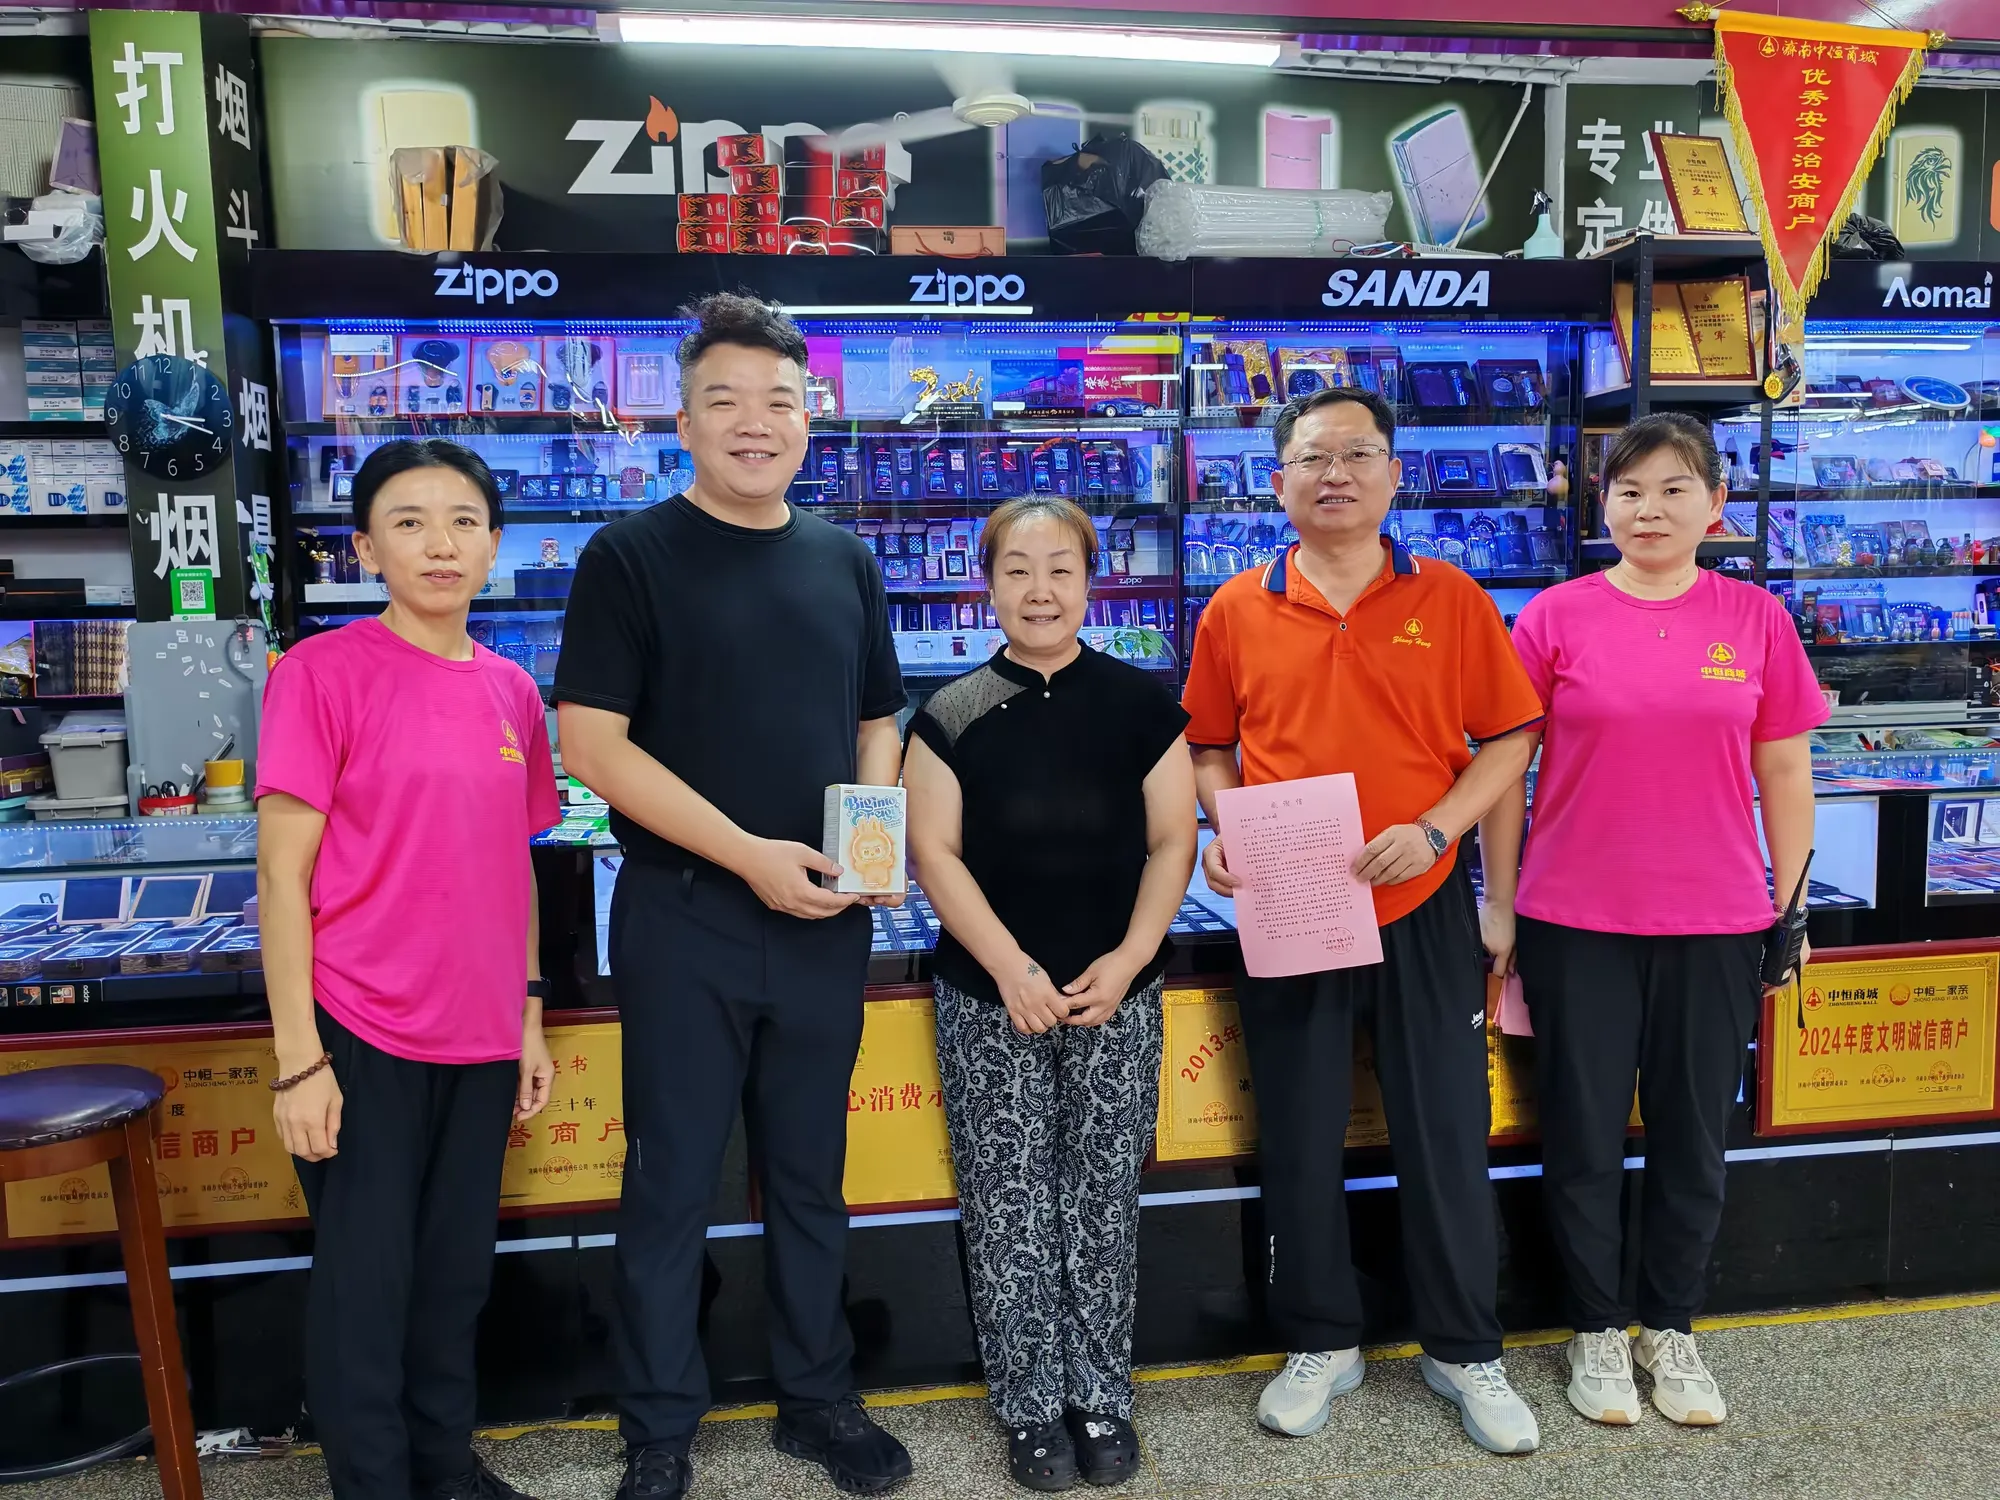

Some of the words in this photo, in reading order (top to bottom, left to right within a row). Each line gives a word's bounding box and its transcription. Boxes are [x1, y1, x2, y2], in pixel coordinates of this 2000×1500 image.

[1785, 68, 1832, 231] 优秀安全治安商户
[113, 42, 208, 369] 打火机
[1322, 269, 1490, 307] SANDA
[131, 364, 146, 380] 11
[155, 357, 173, 374] 12
[189, 365, 196, 381] 1
[113, 383, 131, 399] 10
[211, 384, 220, 401] 2
[107, 408, 118, 425] 9
[222, 410, 231, 428] 3
[119, 434, 130, 452] 8
[212, 436, 223, 453] 4
[140, 451, 150, 469] 7
[167, 458, 178, 476] 6
[194, 453, 204, 471] 5
[150, 493, 221, 580] 烟
[1828, 988, 1879, 1002] 中恒商城
[1913, 984, 1969, 998] 中恒一家亲
[1799, 1017, 1969, 1057] 2024年度文明诚信商户
[1180, 1023, 1242, 1083] 2013年
[183, 1066, 259, 1081] 中恒一家亲
[168, 1103, 186, 1116] 度
[546, 1097, 598, 1113] 三十年
